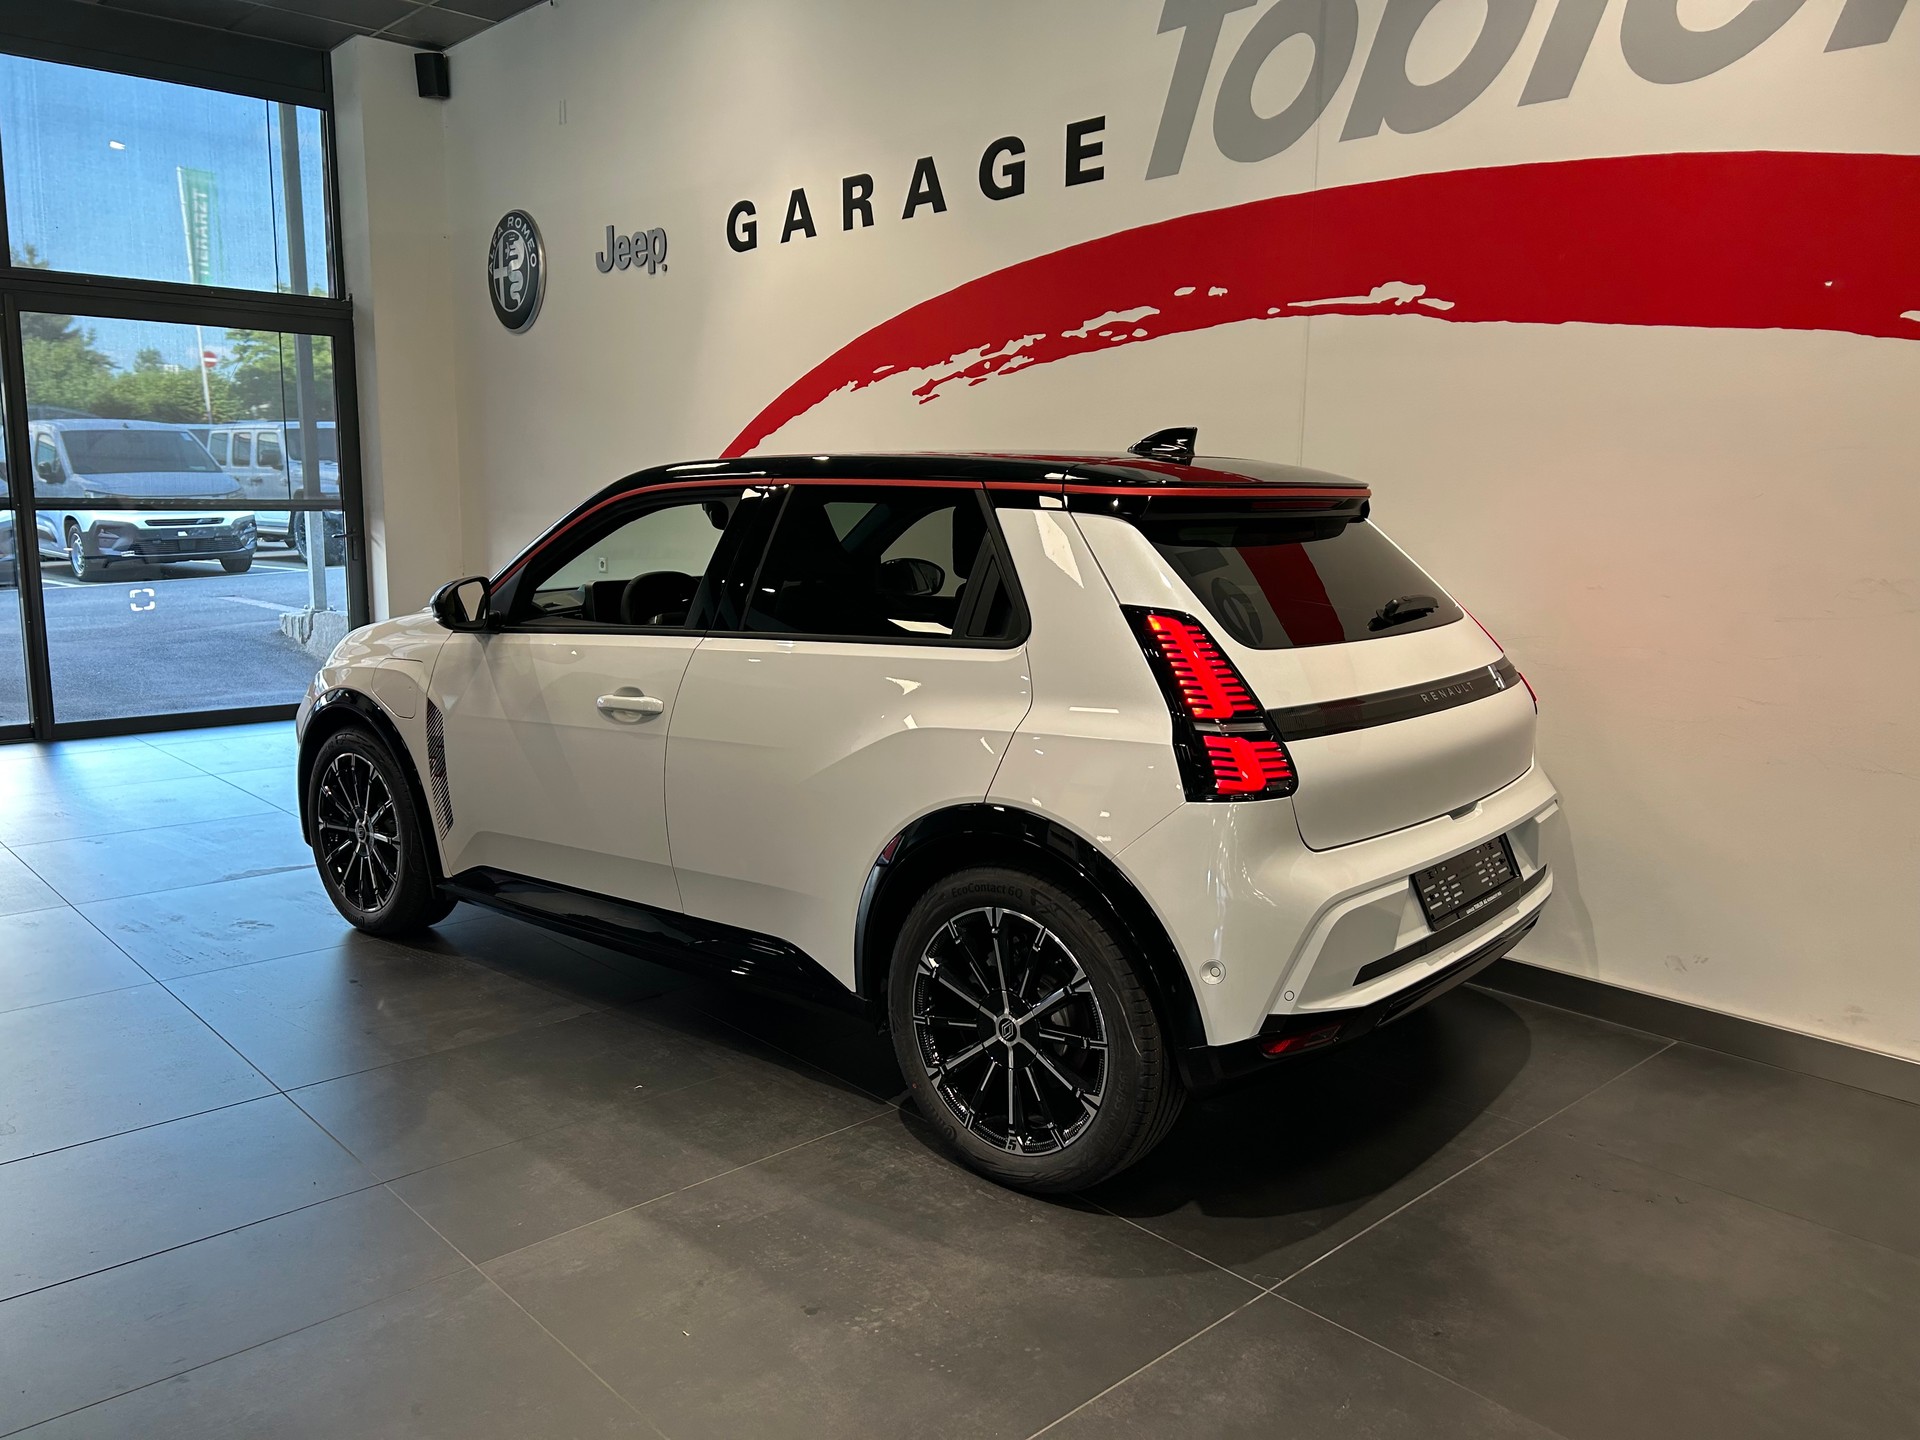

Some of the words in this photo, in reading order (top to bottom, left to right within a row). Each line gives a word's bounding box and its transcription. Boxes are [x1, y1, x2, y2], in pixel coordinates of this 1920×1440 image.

[726, 115, 1106, 253] GARAGE
[1144, 0, 1912, 181] Tob
[488, 225, 503, 275] ALFA
[507, 216, 537, 267] ROMEO
[595, 224, 668, 275] Jeep
[1420, 682, 1475, 703] RENAULT
[951, 882, 1006, 898] EcoContact
[1007, 885, 1024, 901] 6Q
